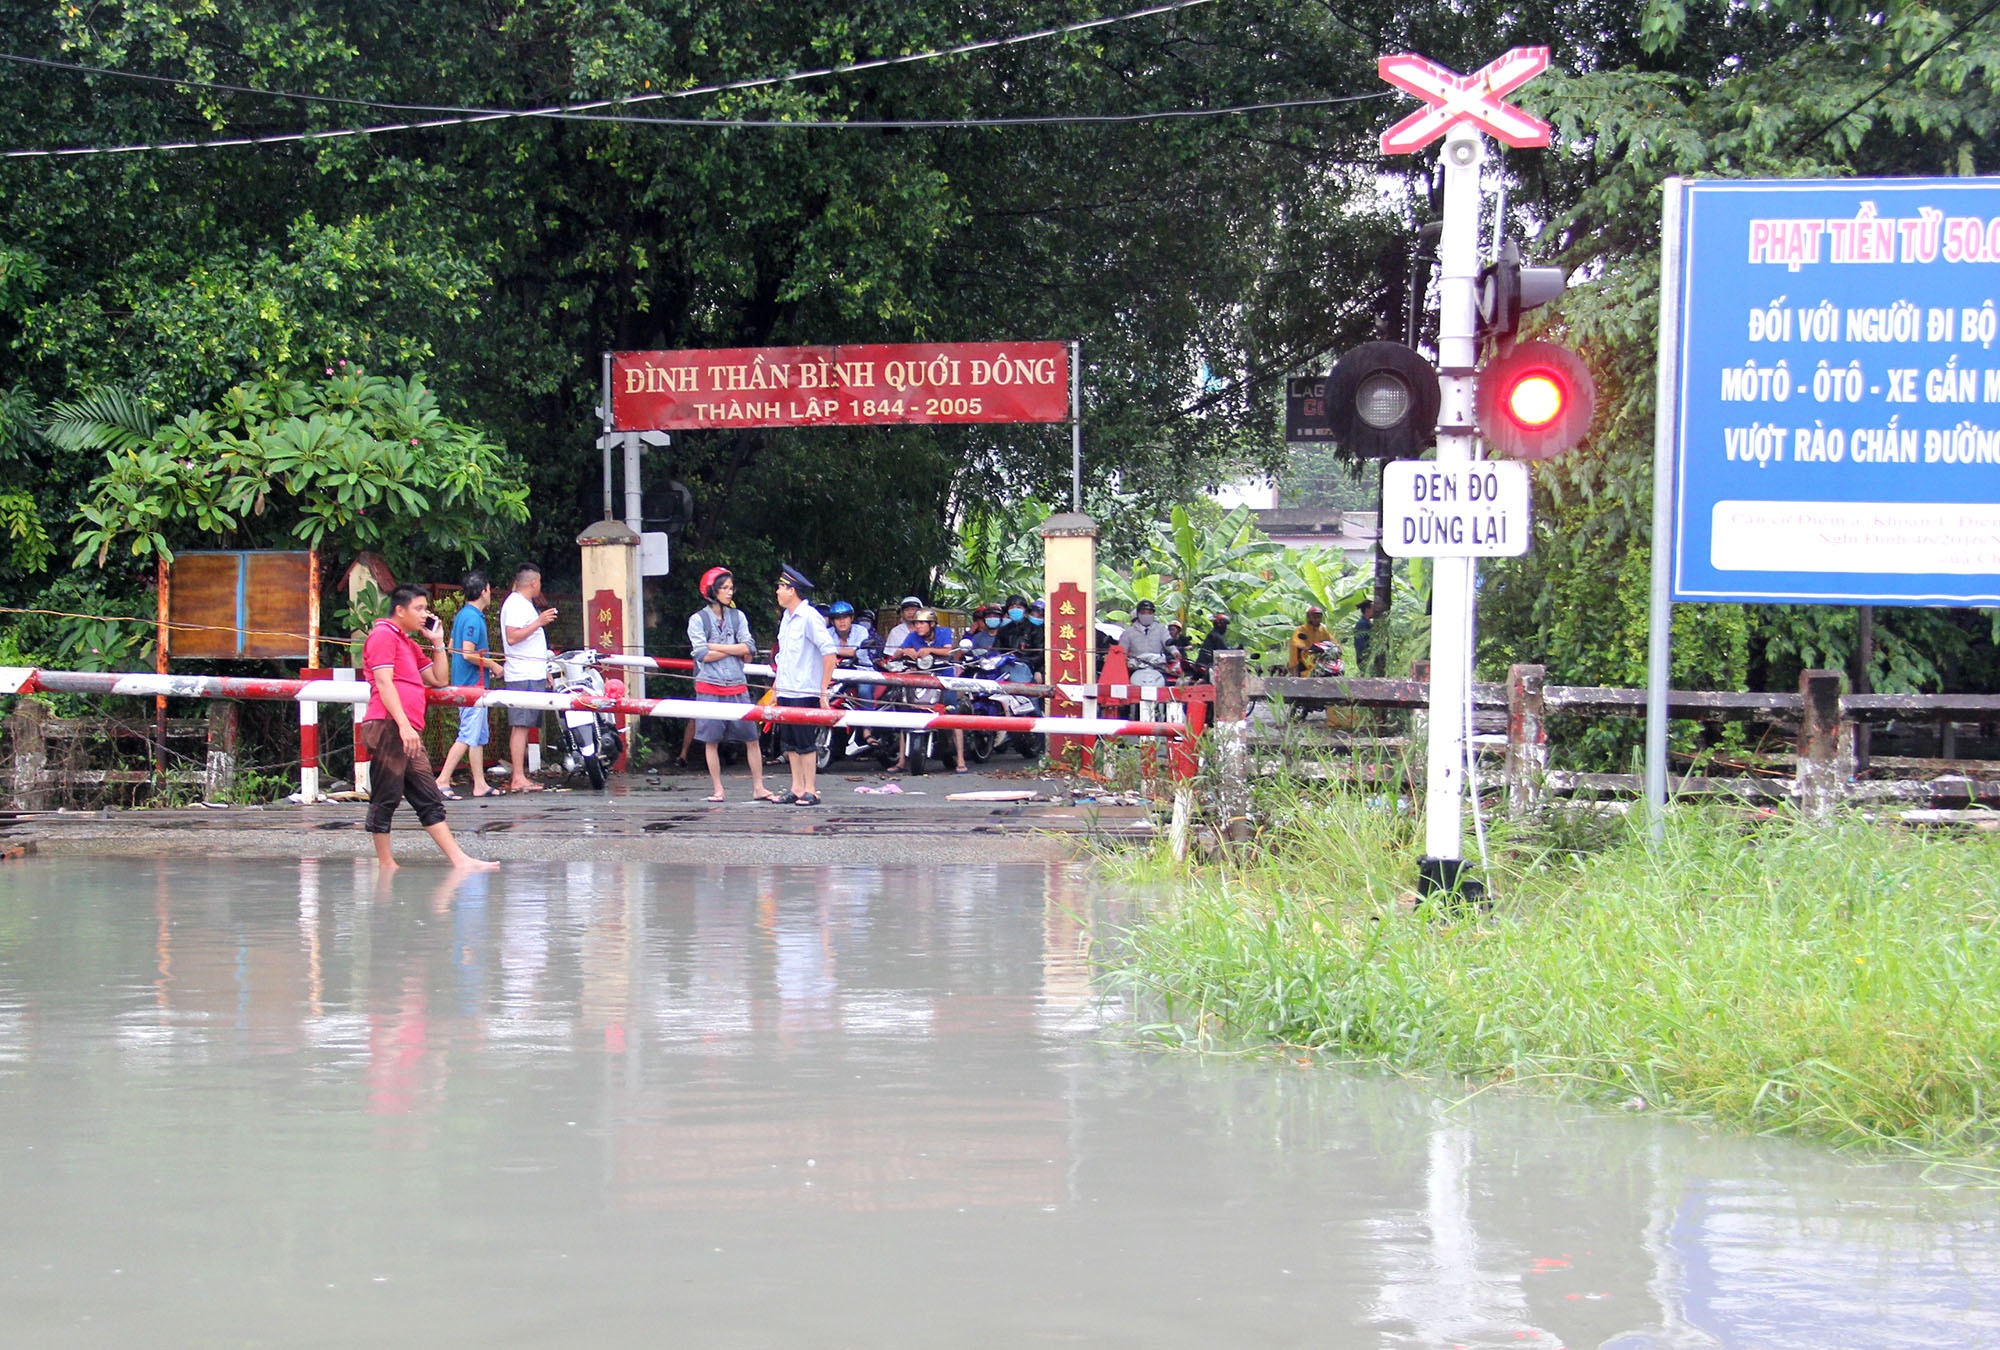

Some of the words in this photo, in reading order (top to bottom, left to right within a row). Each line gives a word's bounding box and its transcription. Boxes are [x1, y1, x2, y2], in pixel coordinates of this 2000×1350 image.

[1748, 219, 1825, 272] PHẠT
[1827, 201, 1895, 264] TIỀN
[1897, 207, 1943, 264] TỪ
[1748, 296, 1790, 342] ĐỐI
[1798, 300, 1839, 342] VỚI
[1846, 300, 1919, 343] NGƯỜI
[1926, 308, 1953, 342] ĐI
[1961, 299, 1996, 350] BỘ
[625, 361, 699, 393] ĐÌNH
[708, 353, 789, 391] THẦN
[798, 356, 875, 389] BÌNH
[884, 352, 961, 392] QUỚI
[969, 352, 1056, 385] ĐÔNG
[1721, 359, 1790, 402] MÔTÔ
[1813, 359, 1862, 402] ÔTÔ
[1885, 368, 1918, 403] XE
[1925, 353, 1977, 403] GẮN
[693, 398, 781, 421] THÀNH
[790, 396, 840, 422] LẬP
[849, 399, 904, 417] 1844
[925, 398, 982, 416] 2005
[1724, 422, 1788, 468] VƯỢT
[1794, 419, 1844, 463] RÀO
[1850, 414, 1917, 463] CHẮN
[1413, 465, 1457, 502] ĐÈN
[1467, 462, 1498, 502] ĐỎ
[1402, 508, 1463, 545] DỪNG
[1472, 512, 1507, 549] LẠI
